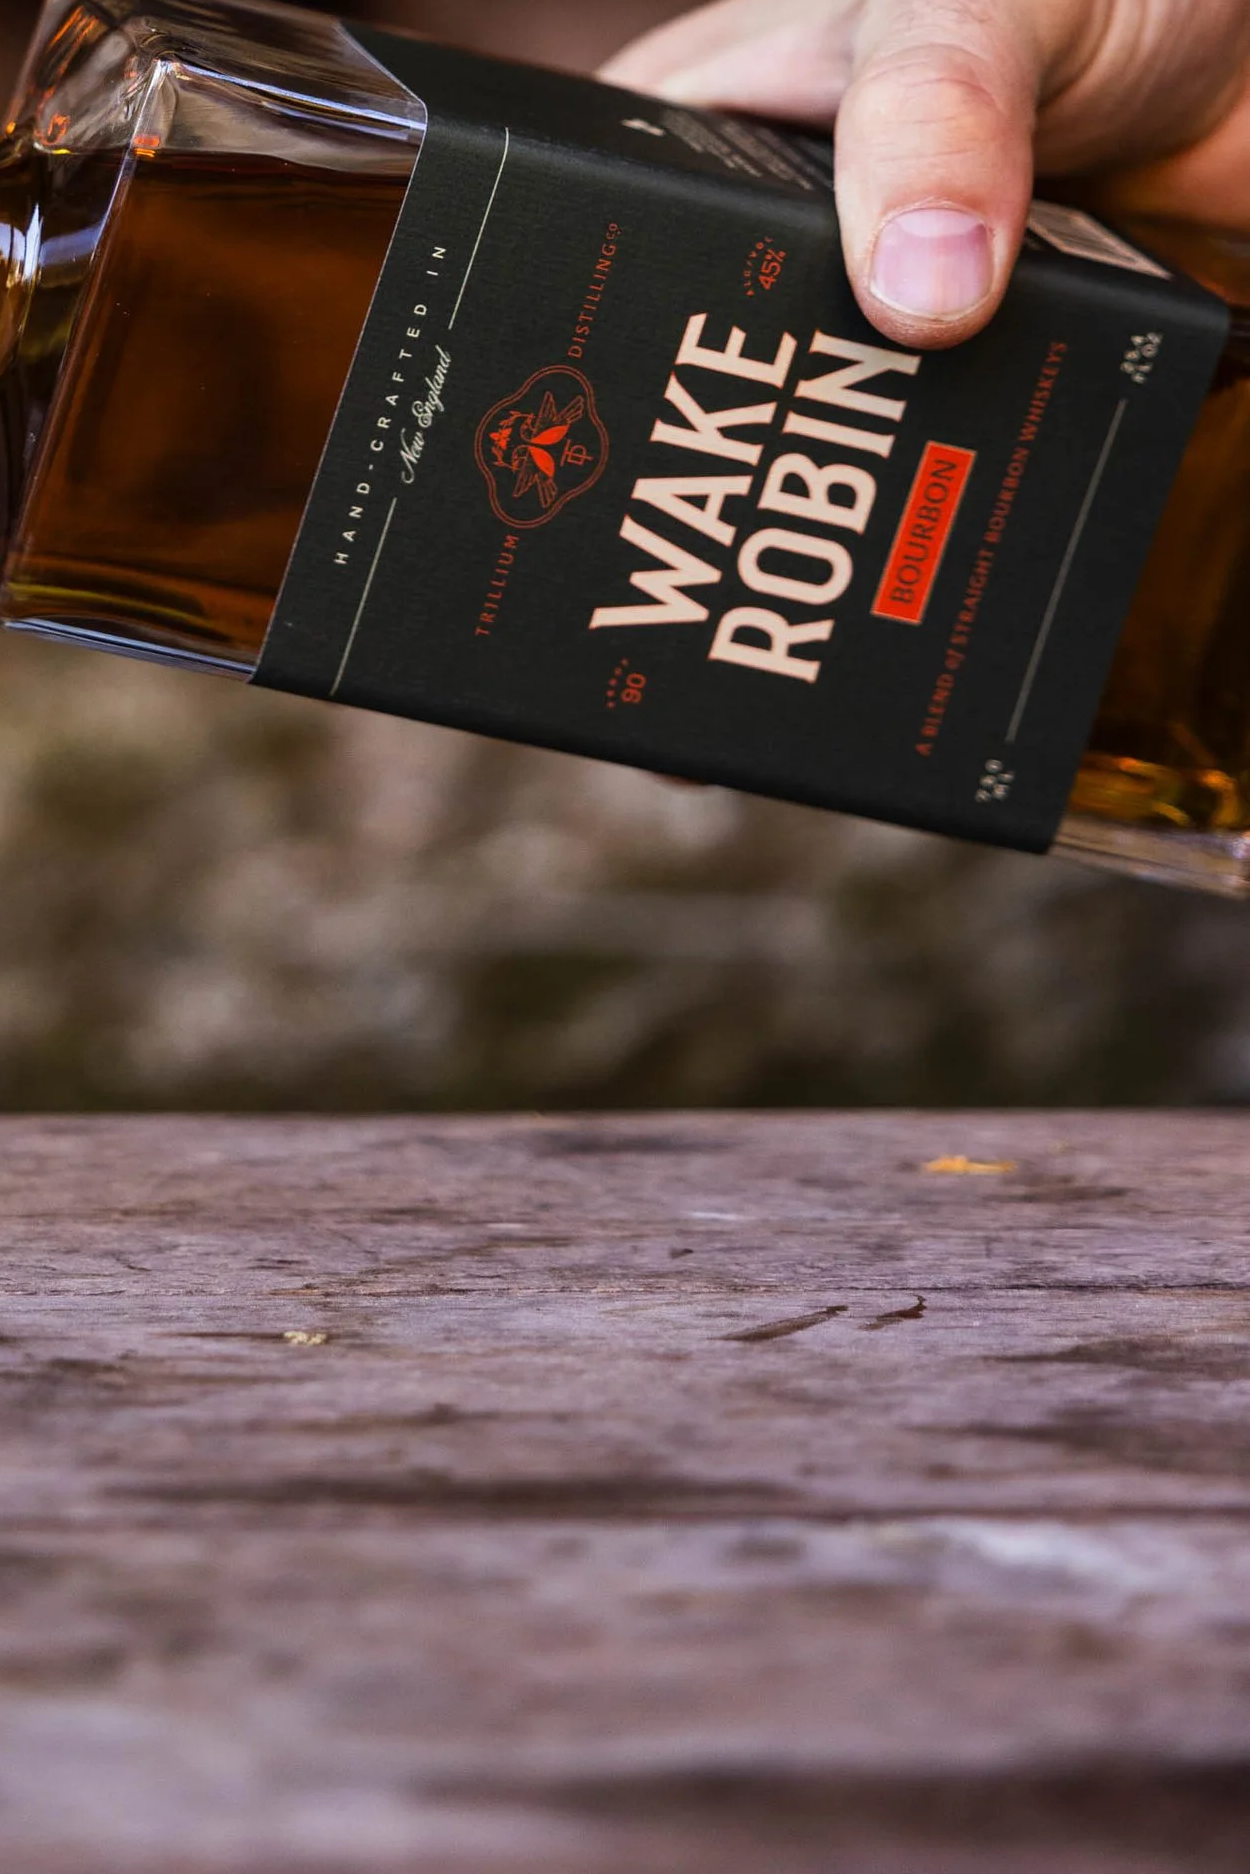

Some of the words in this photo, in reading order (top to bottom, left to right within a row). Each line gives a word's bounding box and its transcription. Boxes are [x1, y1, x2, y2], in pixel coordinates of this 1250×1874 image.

[757, 248, 786, 290] 45%
[333, 303, 427, 565] HAND-CRAFTED
[425, 245, 446, 276] IN
[410, 343, 451, 428] England
[1017, 342, 1067, 441] WHISKEYS
[398, 427, 425, 484] New
[589, 312, 797, 629] WAKE
[983, 447, 1028, 543] BOURBON
[708, 330, 920, 683] ROBIN
[890, 458, 957, 603] BOURBON
[474, 533, 519, 635] TRILLIUM
[949, 549, 993, 644] STRAIGHT
[620, 672, 646, 703] 90
[921, 673, 953, 737] BLEND
[914, 741, 932, 756] A
